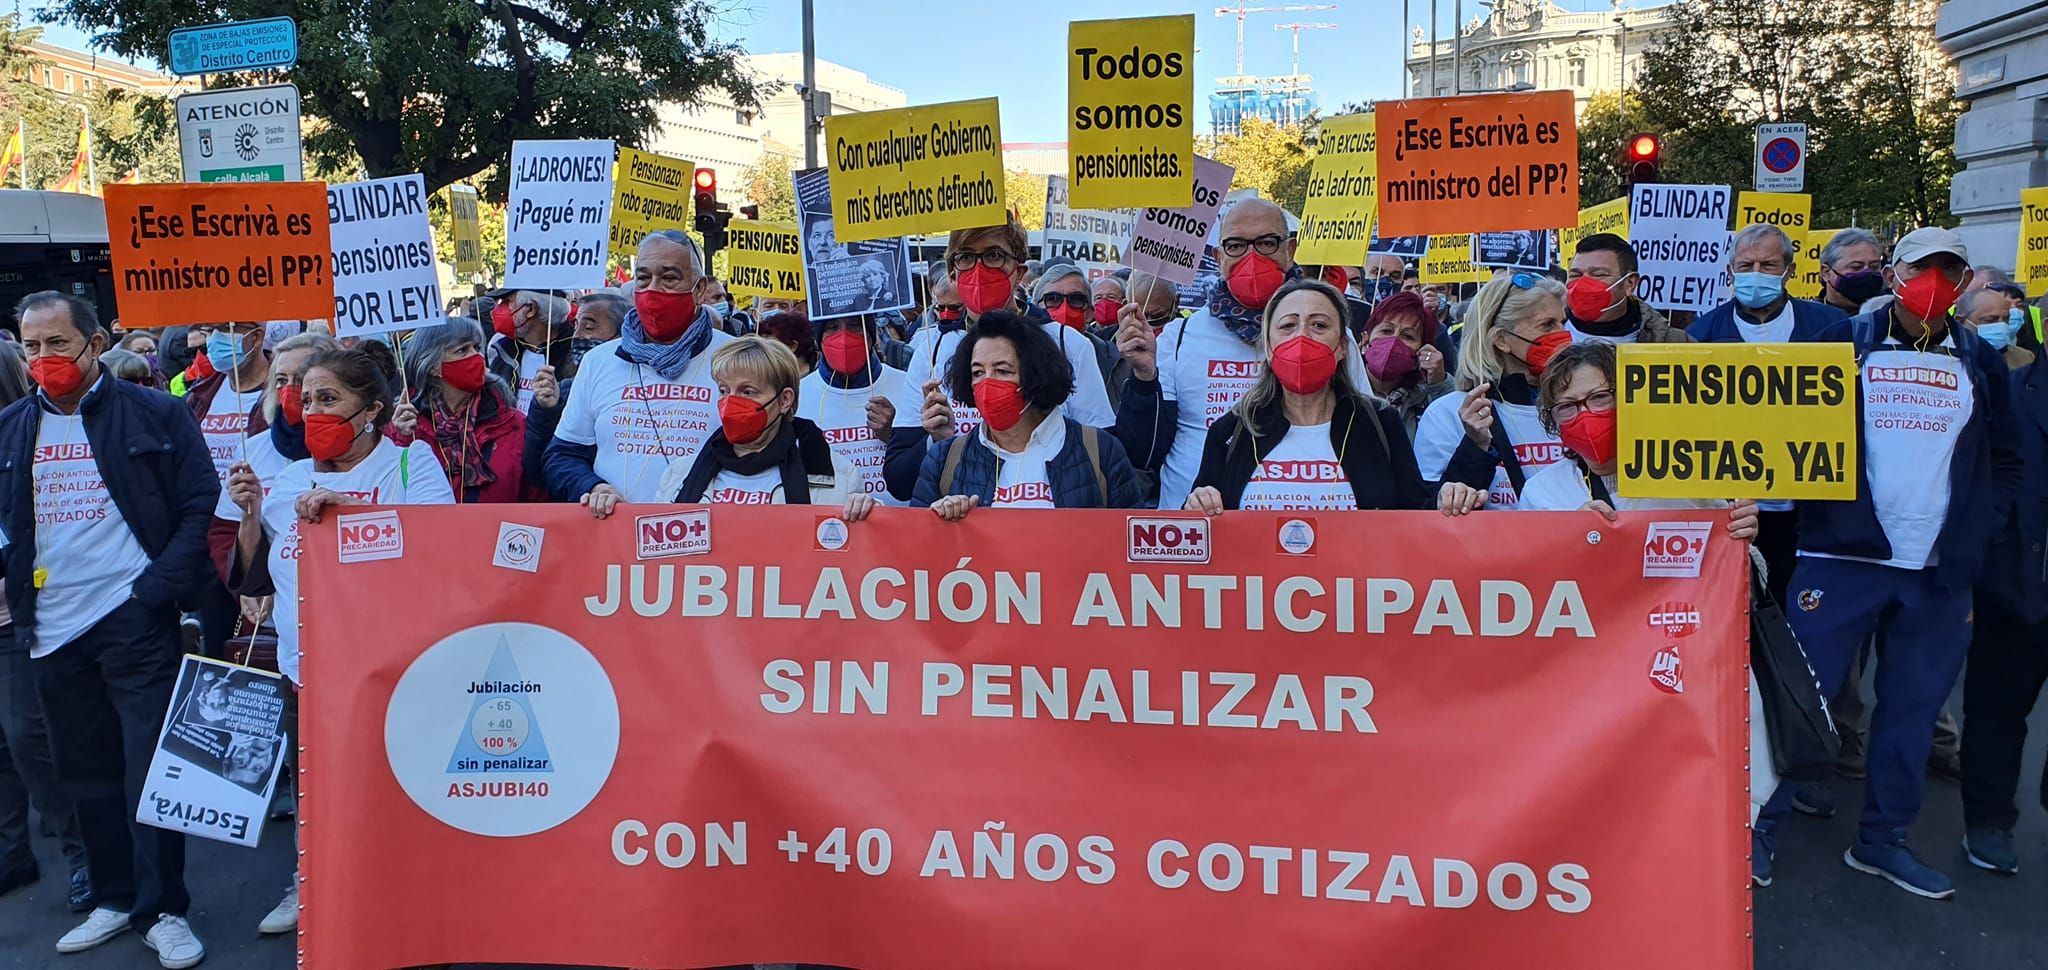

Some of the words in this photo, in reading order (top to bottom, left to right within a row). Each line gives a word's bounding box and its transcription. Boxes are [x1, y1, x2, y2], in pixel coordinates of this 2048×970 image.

[200, 31, 216, 41] ZONA
[219, 31, 228, 39] DE
[230, 29, 250, 38] BAJAS
[252, 24, 288, 35] EMISIONES
[201, 43, 211, 51] DE
[212, 40, 243, 50] ESPECIAL
[245, 35, 287, 46] PROTECCIÓN
[201, 53, 243, 68] Distrito
[247, 49, 290, 63] Centro
[1075, 45, 1183, 80] Todos
[186, 97, 289, 122] ATENCIÓN
[1075, 103, 1183, 130] somos
[1395, 119, 1442, 161] ¿Ese
[1449, 113, 1529, 149] Escrivà
[1535, 121, 1559, 144] es
[1776, 126, 1805, 134] ACERA
[836, 137, 863, 171] Con
[867, 126, 927, 172] cualquier
[931, 120, 995, 159] Gobierno,
[1318, 129, 1335, 155] Sin
[516, 156, 606, 190] ¡LADRONES!
[630, 154, 685, 187] Pensionazo:
[1075, 146, 1182, 186] pensionistas.
[1309, 171, 1325, 198] de
[1326, 165, 1375, 197] ladrón:
[1387, 169, 1480, 202] ministro
[1487, 165, 1520, 197] del
[1528, 162, 1568, 195] PP?
[328, 179, 423, 224] BLINDAR
[619, 189, 640, 212] robo
[642, 199, 682, 222] agravado
[847, 188, 871, 224] mis
[873, 180, 933, 220] derechos
[937, 170, 997, 211] defiendo.
[1047, 186, 1068, 206] PLA
[1633, 189, 1725, 224] ¡BLINDAR
[514, 198, 574, 232] ¡Pagué
[579, 200, 604, 224] mi
[1046, 211, 1067, 231] DEL
[1069, 213, 1118, 237] SISTEMA
[1145, 207, 1208, 238] somos
[1598, 210, 1626, 233] Gobierno,
[1743, 207, 1804, 226] Todos
[130, 205, 184, 249] ¿Ese
[191, 204, 279, 237] Escrivà
[286, 211, 312, 236] es
[611, 221, 620, 242] al
[620, 227, 631, 248] ya
[1297, 214, 1318, 247] ¡Mi
[1313, 210, 1368, 247] pensión!
[730, 230, 799, 255] PENSIONES
[1047, 239, 1121, 263] TRABA
[1133, 235, 1196, 270] pensionistas.
[1429, 236, 1438, 250] on
[1439, 234, 1471, 251] cualquier
[1632, 233, 1719, 263] pensiones
[331, 239, 431, 280] pensiones
[512, 240, 600, 274] pensión!
[1426, 258, 1438, 275] mis
[1440, 256, 1470, 274] derechos
[124, 257, 230, 292] ministro
[237, 256, 274, 288] del
[282, 255, 323, 286] PP?
[729, 265, 774, 293] JUSTAS,
[777, 270, 801, 291] YA!
[1637, 275, 1665, 303] OR
[1670, 276, 1715, 306] LEY!
[335, 291, 382, 331] POR
[389, 285, 439, 324] LEY!
[829, 298, 854, 308] dinero
[1211, 362, 1261, 377] ASJU
[1871, 368, 1957, 387] ASJUBI40
[624, 384, 709, 400] ASJUBI40
[1624, 364, 1845, 406] PENSIONES
[1207, 392, 1228, 403] SIN
[1868, 393, 1888, 404] SIN
[1893, 393, 1961, 409] PENALIZAR
[662, 408, 710, 419] ANTICIPADA
[1206, 406, 1224, 415] CON
[1870, 410, 1887, 418] CON
[1934, 414, 1954, 423] AÑOS
[611, 415, 631, 425] SIN
[635, 417, 707, 431] PENALIZAR
[1874, 419, 1947, 433] COTIZADOS
[675, 435, 700, 444] AÑOS
[824, 427, 874, 444] SJUBI
[35, 444, 93, 461] SJUBI
[616, 442, 696, 457] COTIZADOS
[1250, 463, 1344, 480] ASJUBI
[1624, 439, 1774, 491] JUSTAS,
[1786, 441, 1845, 482] YA!
[1320, 493, 1354, 501] ANTIC
[1490, 492, 1516, 504] SIN
[37, 508, 105, 524] OTIZADOS
[341, 524, 396, 544] NO+
[642, 519, 706, 545] NO+
[1133, 524, 1203, 548] NO+
[341, 540, 397, 551] PRECARIEDAD
[643, 540, 707, 552] PRECARIEDAD
[1134, 547, 1204, 556] PRECARIEDAD
[1646, 535, 1703, 556] NO+
[583, 557, 1041, 625] JUBILACIÓN
[1072, 572, 1597, 639] ANTICIPADA
[1650, 611, 1700, 625] CCOO
[248, 681, 277, 695] dinero
[467, 681, 541, 694] Jubilación
[759, 659, 888, 714] SIN
[921, 661, 1378, 734] PENALIZAR
[497, 701, 511, 711] 65
[498, 719, 512, 729] 40
[482, 737, 503, 747] 100
[507, 737, 517, 748] %
[457, 757, 478, 770] sin
[483, 757, 548, 772] penalizar
[447, 782, 549, 798] ASJUBI40
[150, 791, 249, 840] Escrivà,
[611, 819, 748, 868] CON
[777, 826, 892, 877] +40
[920, 820, 1116, 885] AÑOS
[1146, 839, 1592, 914] COTIZADOS
